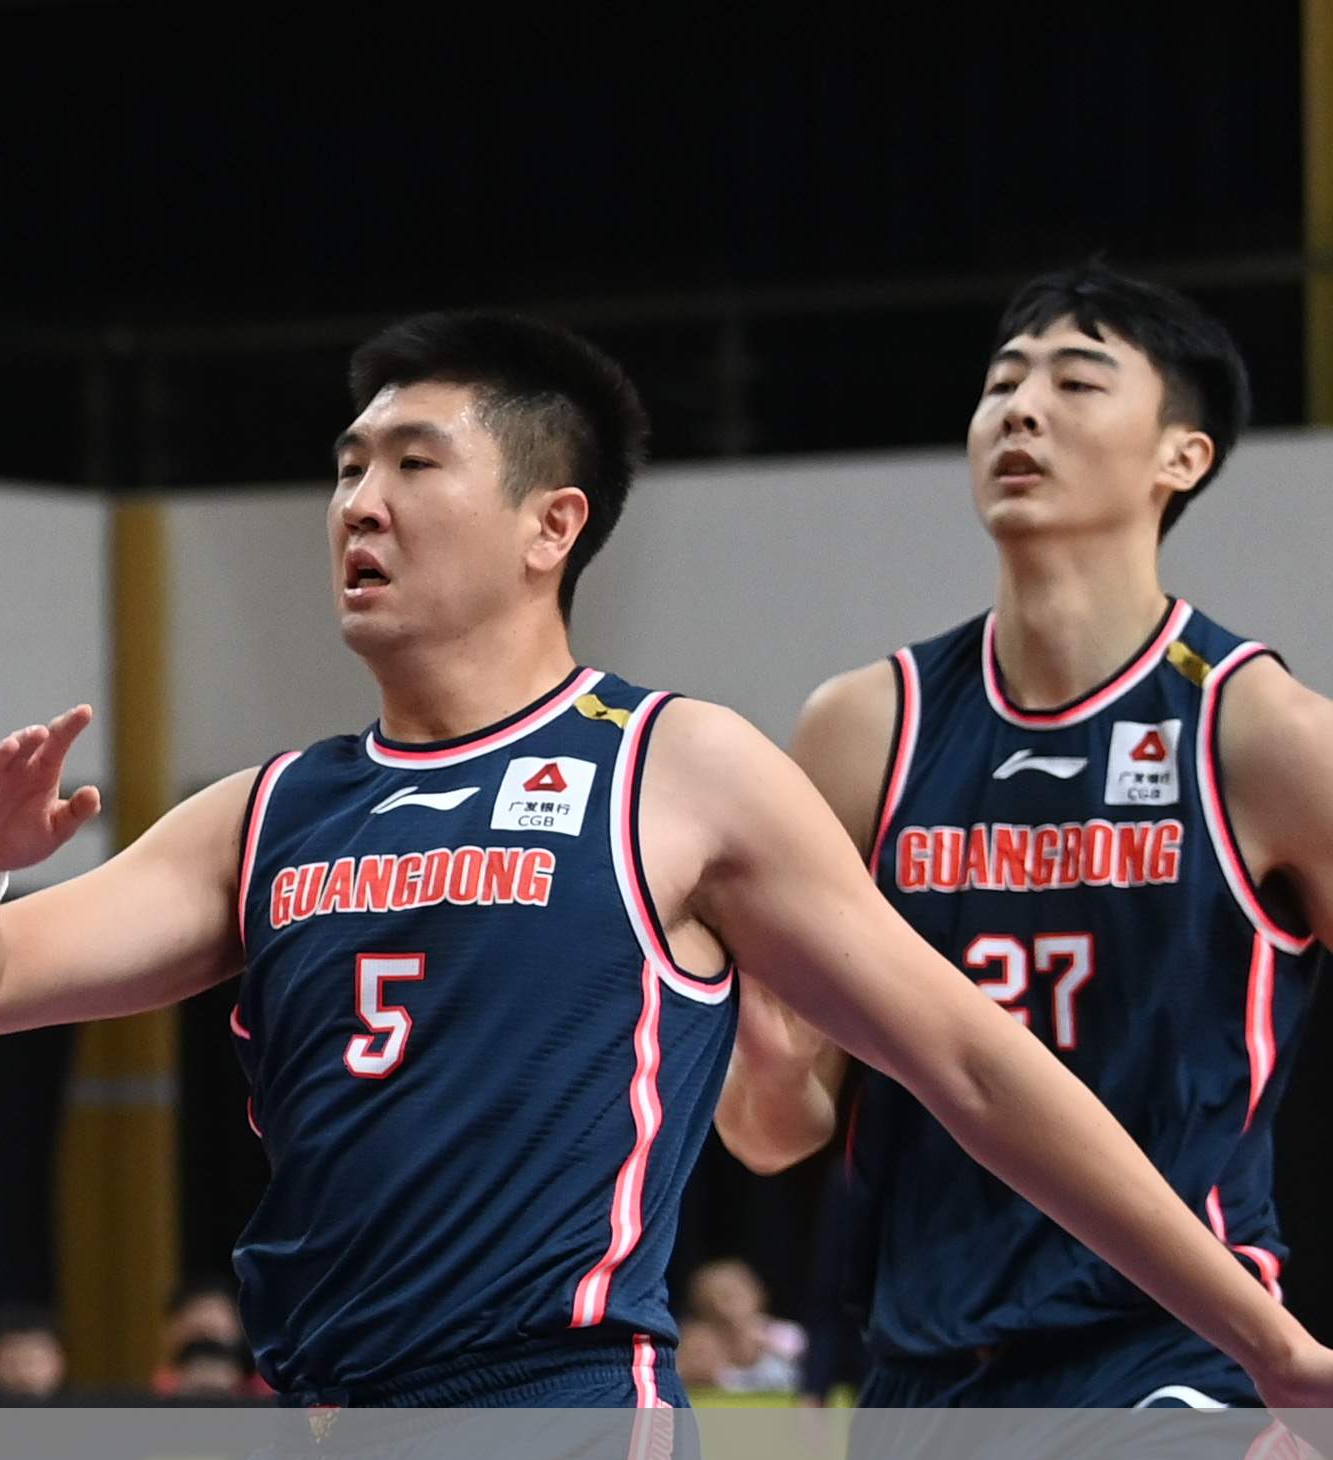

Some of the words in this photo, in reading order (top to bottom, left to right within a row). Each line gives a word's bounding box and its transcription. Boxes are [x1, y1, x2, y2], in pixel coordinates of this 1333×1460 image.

[508, 801, 571, 815] 广发银行
[517, 815, 555, 827] CGB
[269, 846, 556, 929] GUANGDONG
[896, 818, 1184, 893] GUANGDONG
[343, 952, 426, 1079] 5
[963, 931, 1094, 1051] 27
